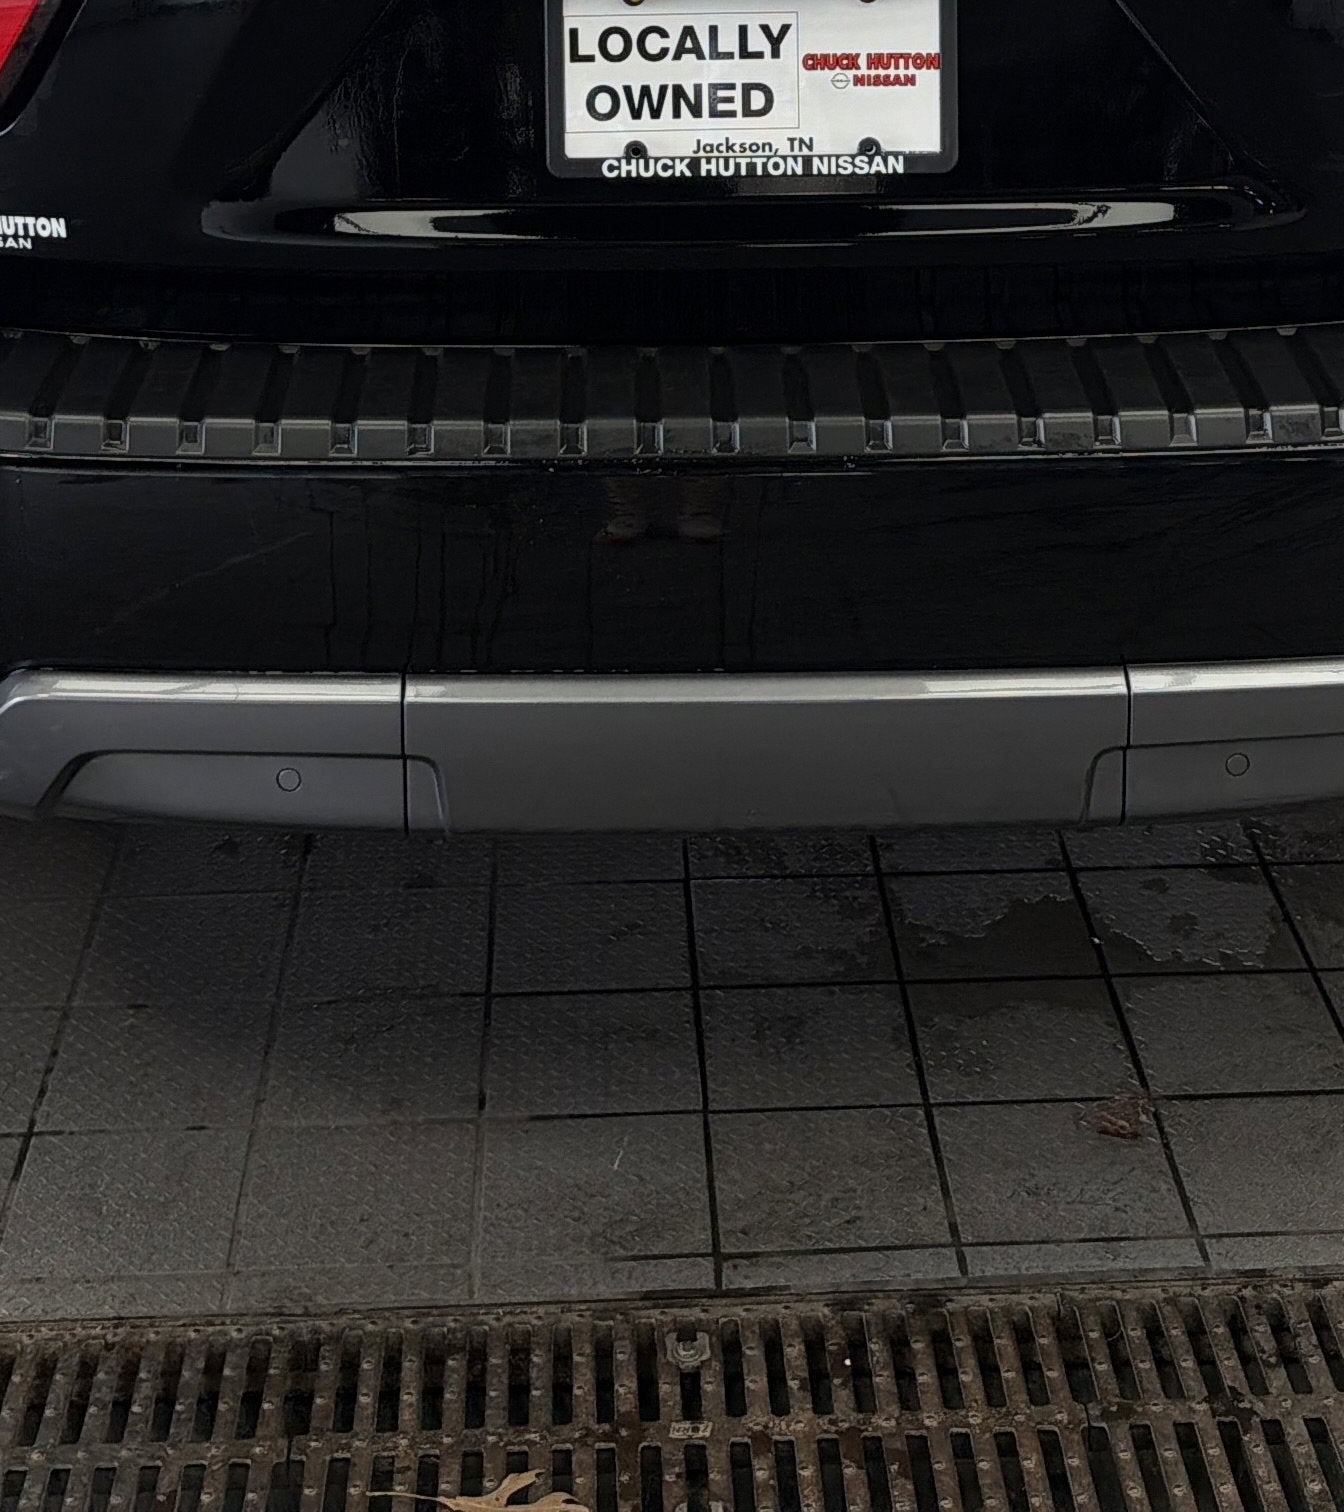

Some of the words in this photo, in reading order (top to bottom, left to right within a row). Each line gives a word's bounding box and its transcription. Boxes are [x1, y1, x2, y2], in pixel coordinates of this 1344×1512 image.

[568, 24, 792, 63] LOCALLY
[802, 53, 861, 71] CHUCK
[866, 53, 942, 70] HUTTON
[853, 74, 916, 87] NISSAN
[585, 82, 775, 122] OWNED
[692, 137, 779, 156] Jackson,
[786, 137, 814, 153] TN
[601, 158, 692, 178] CHUCK
[700, 156, 803, 177] HUTTON
[812, 155, 905, 176] NISSAN
